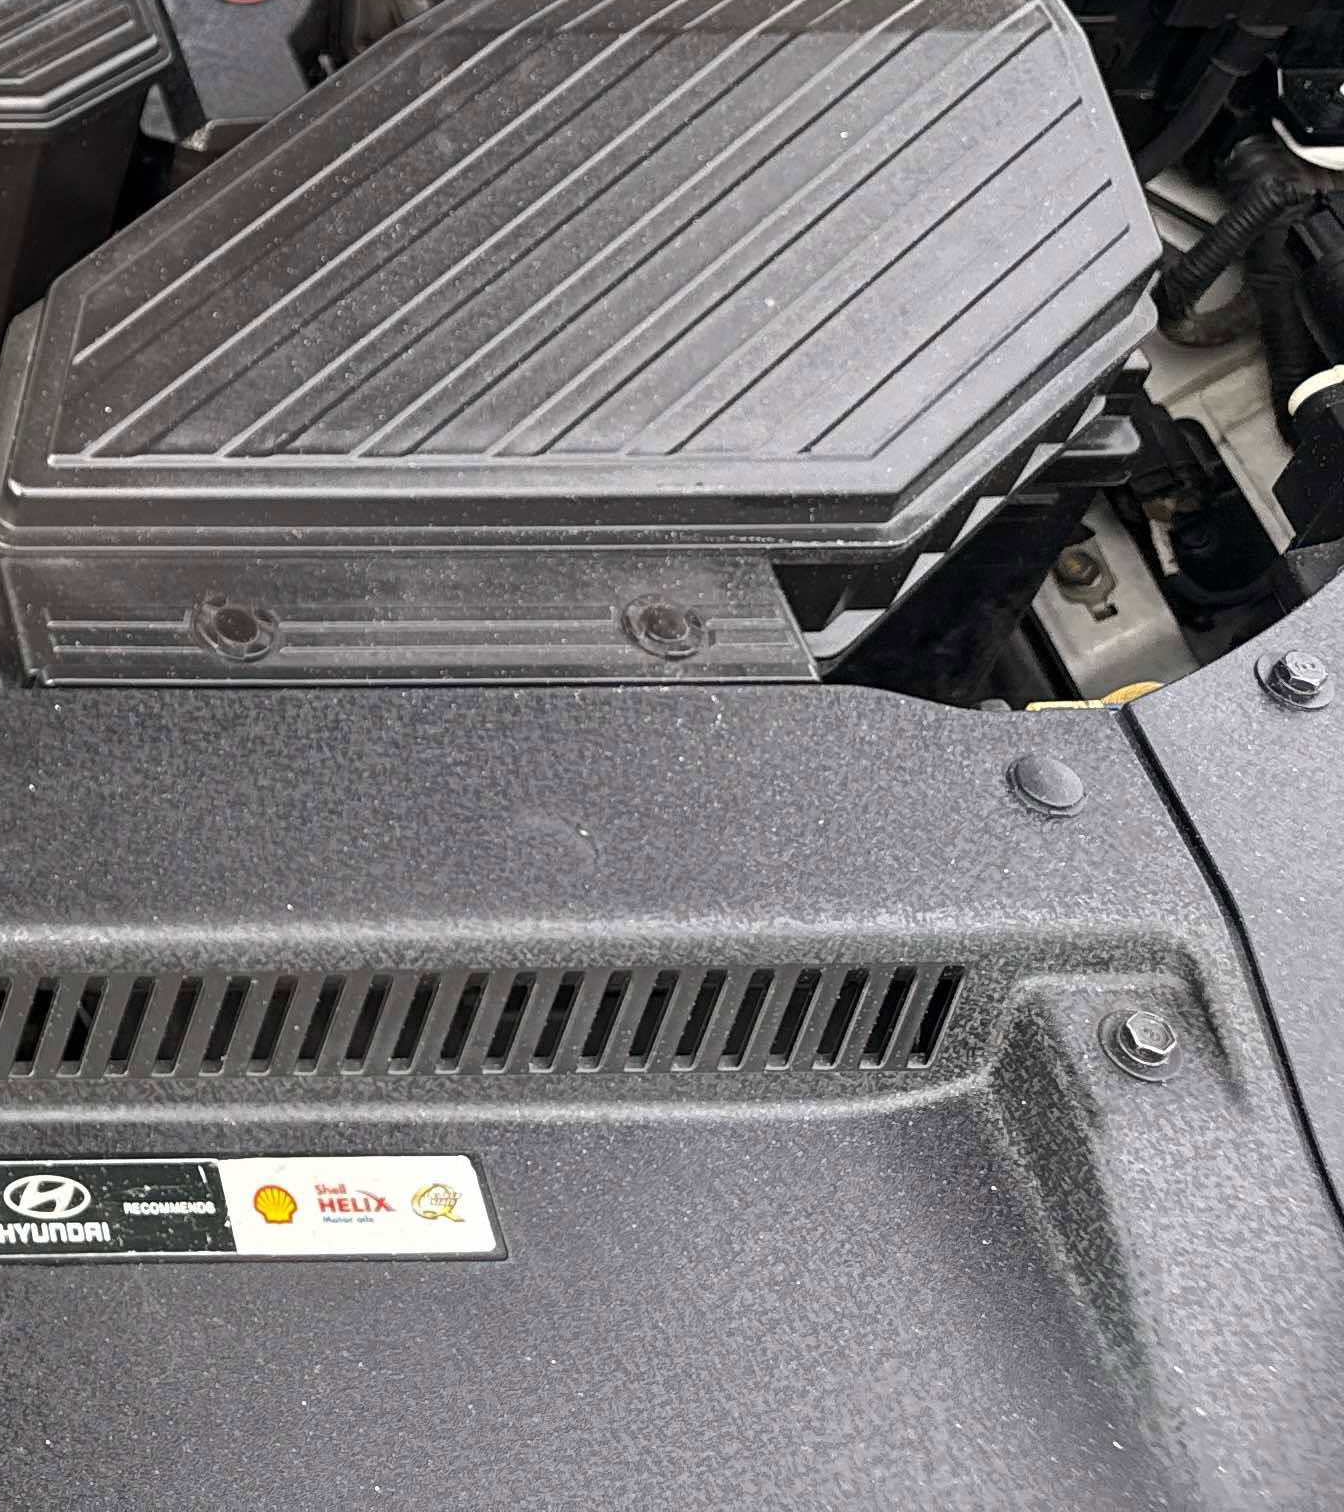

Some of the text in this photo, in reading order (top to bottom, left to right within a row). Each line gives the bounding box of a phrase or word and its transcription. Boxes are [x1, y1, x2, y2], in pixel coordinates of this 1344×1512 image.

[314, 1183, 348, 1195] Shell
[122, 1200, 216, 1216] RECOMMENDS
[317, 1195, 397, 1213] HELIX
